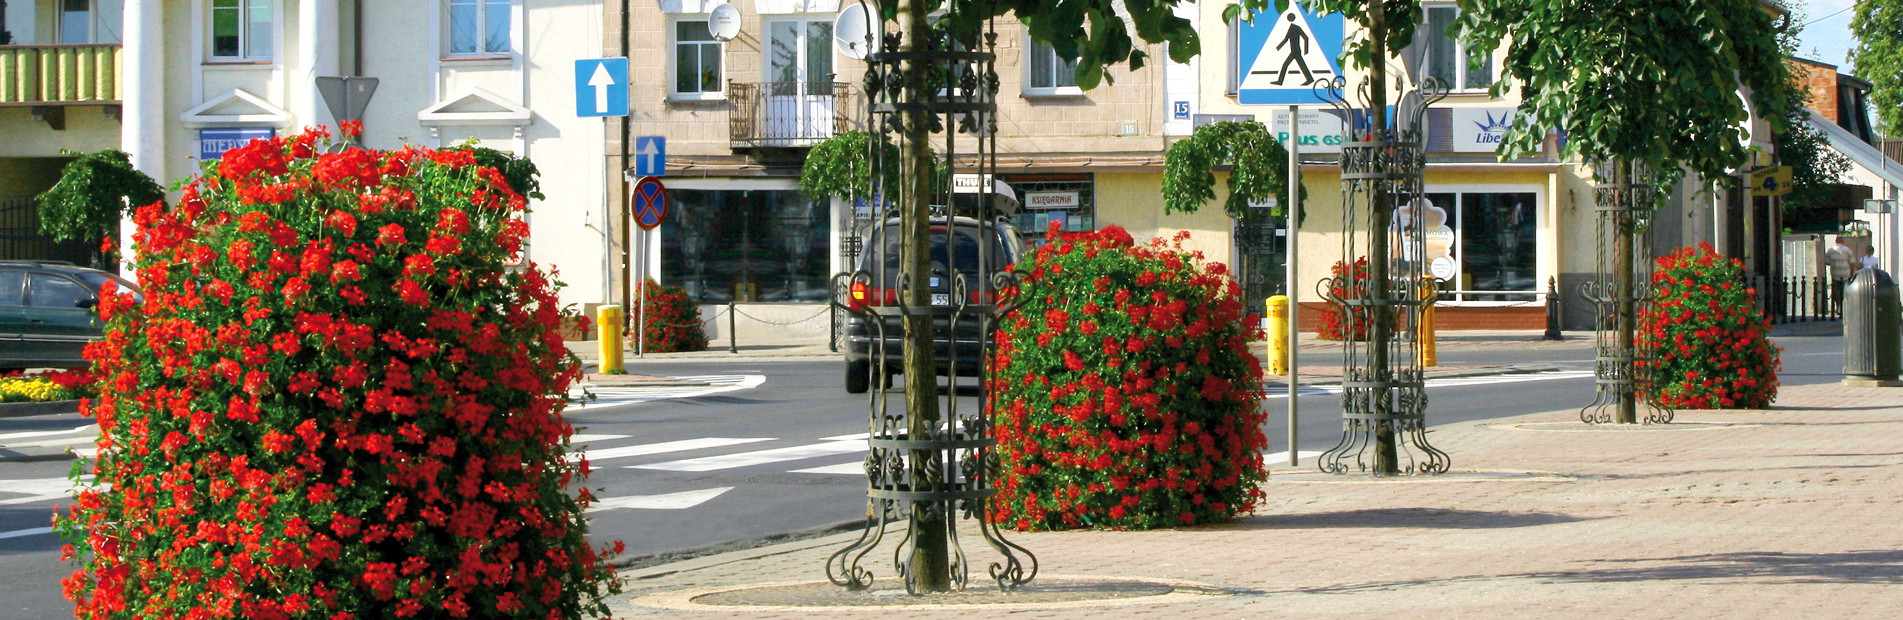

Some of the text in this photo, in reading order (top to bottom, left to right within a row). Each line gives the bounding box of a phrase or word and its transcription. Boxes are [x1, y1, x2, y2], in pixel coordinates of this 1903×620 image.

[1175, 103, 1188, 114] 15
[1125, 125, 1135, 133] 15
[1277, 131, 1318, 145] Pus
[1476, 132, 1502, 143] Libe
[203, 139, 250, 153] MEDY
[956, 178, 990, 187] THUE
[1763, 176, 1777, 191] 4
[1032, 195, 1072, 205] KSIĘGARNIA
